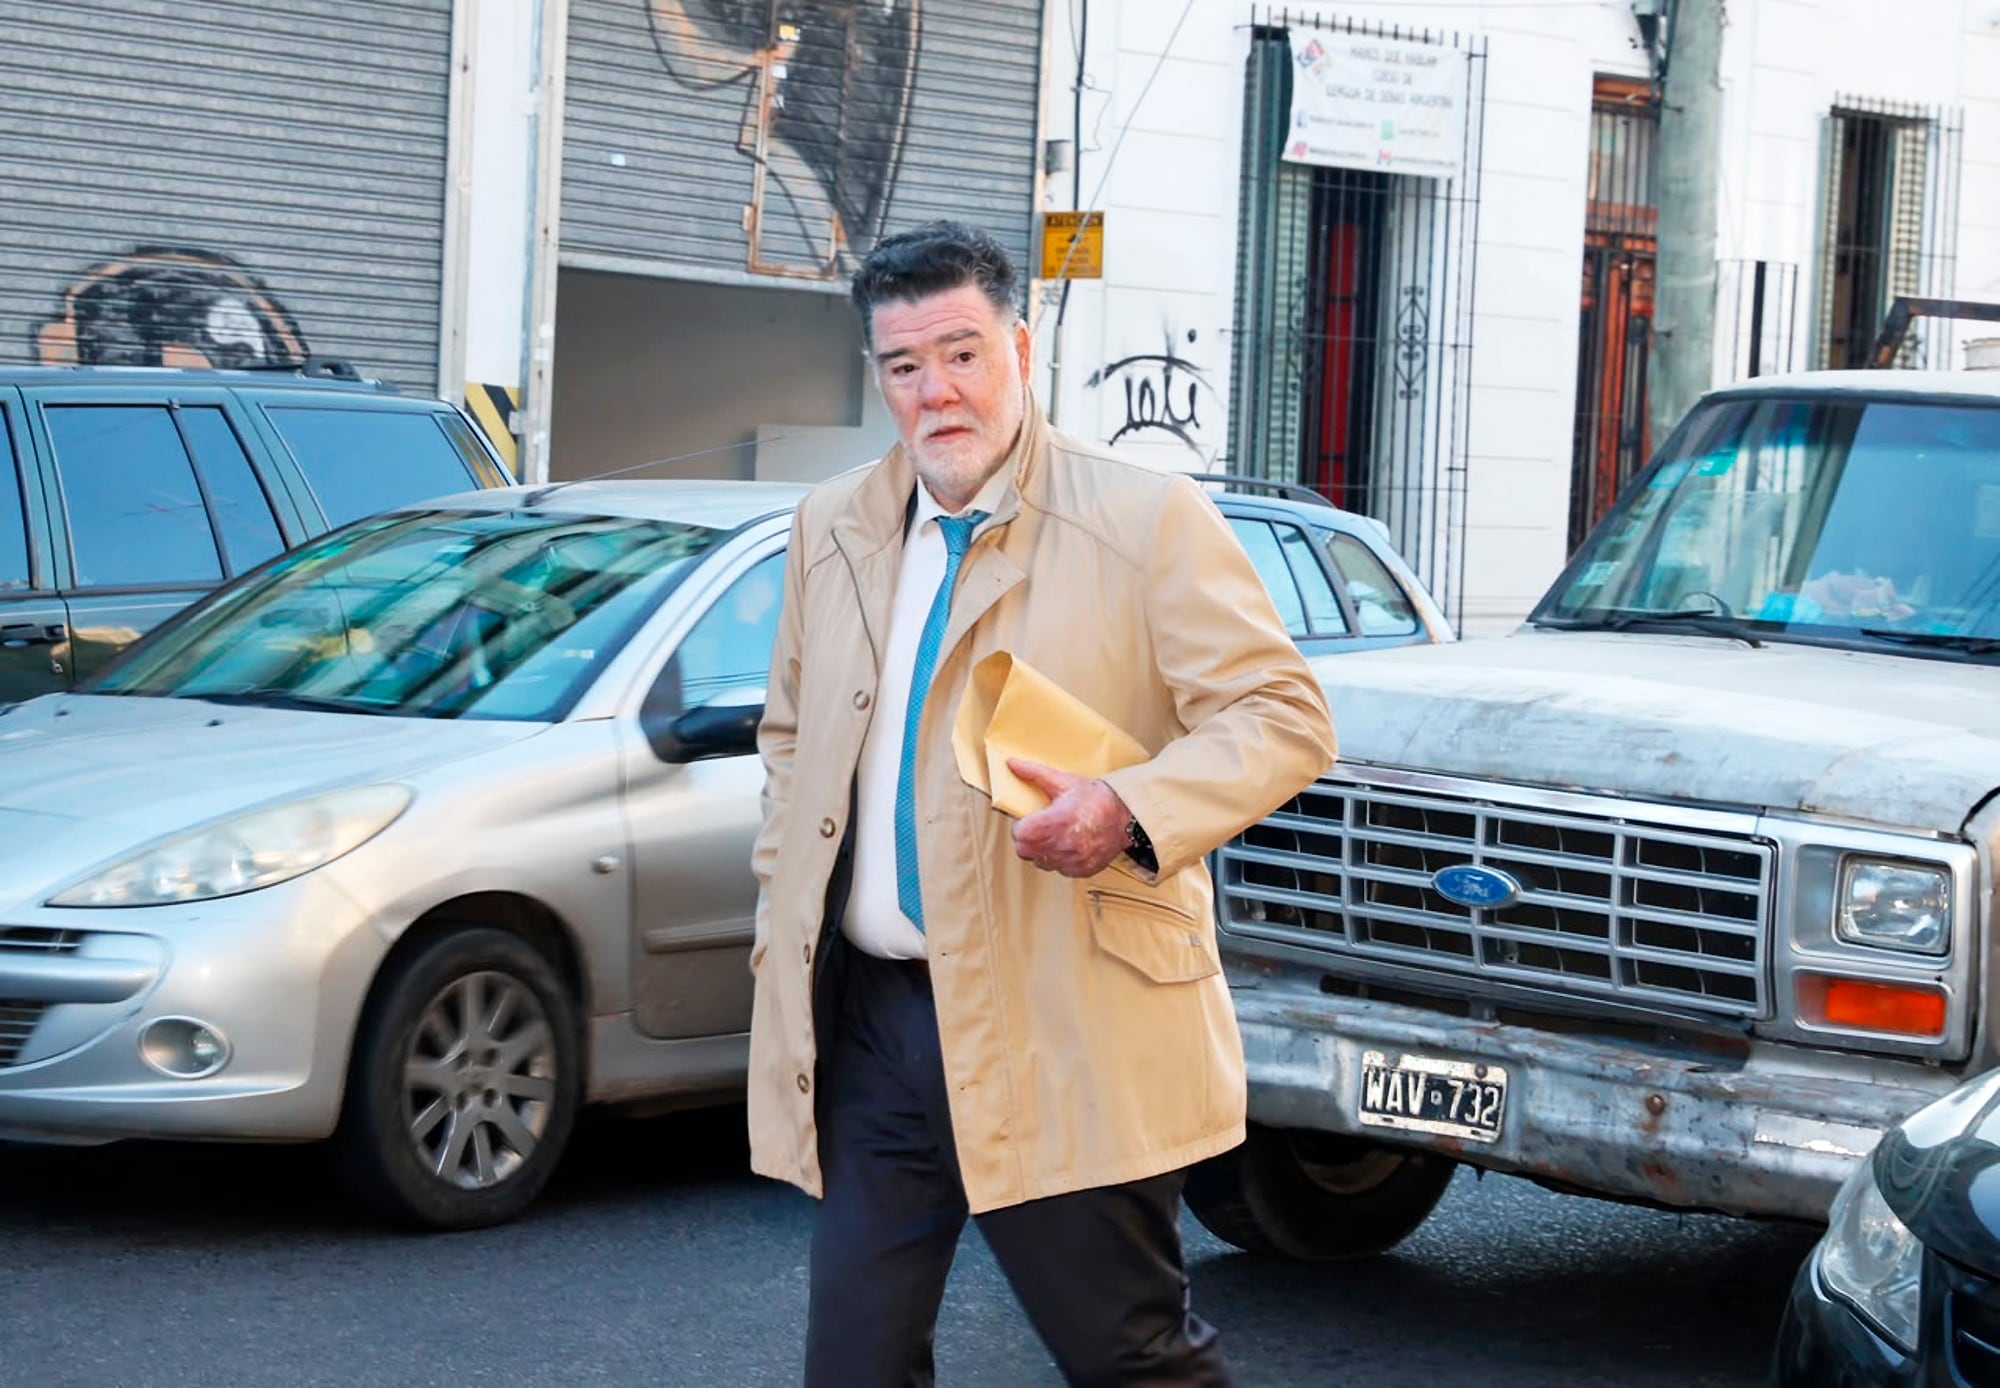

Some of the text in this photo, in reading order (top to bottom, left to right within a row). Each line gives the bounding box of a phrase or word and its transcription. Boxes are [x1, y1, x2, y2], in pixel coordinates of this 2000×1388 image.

[1448, 873, 1493, 898] Ford
[1365, 1068, 1499, 1127] WAV 732
